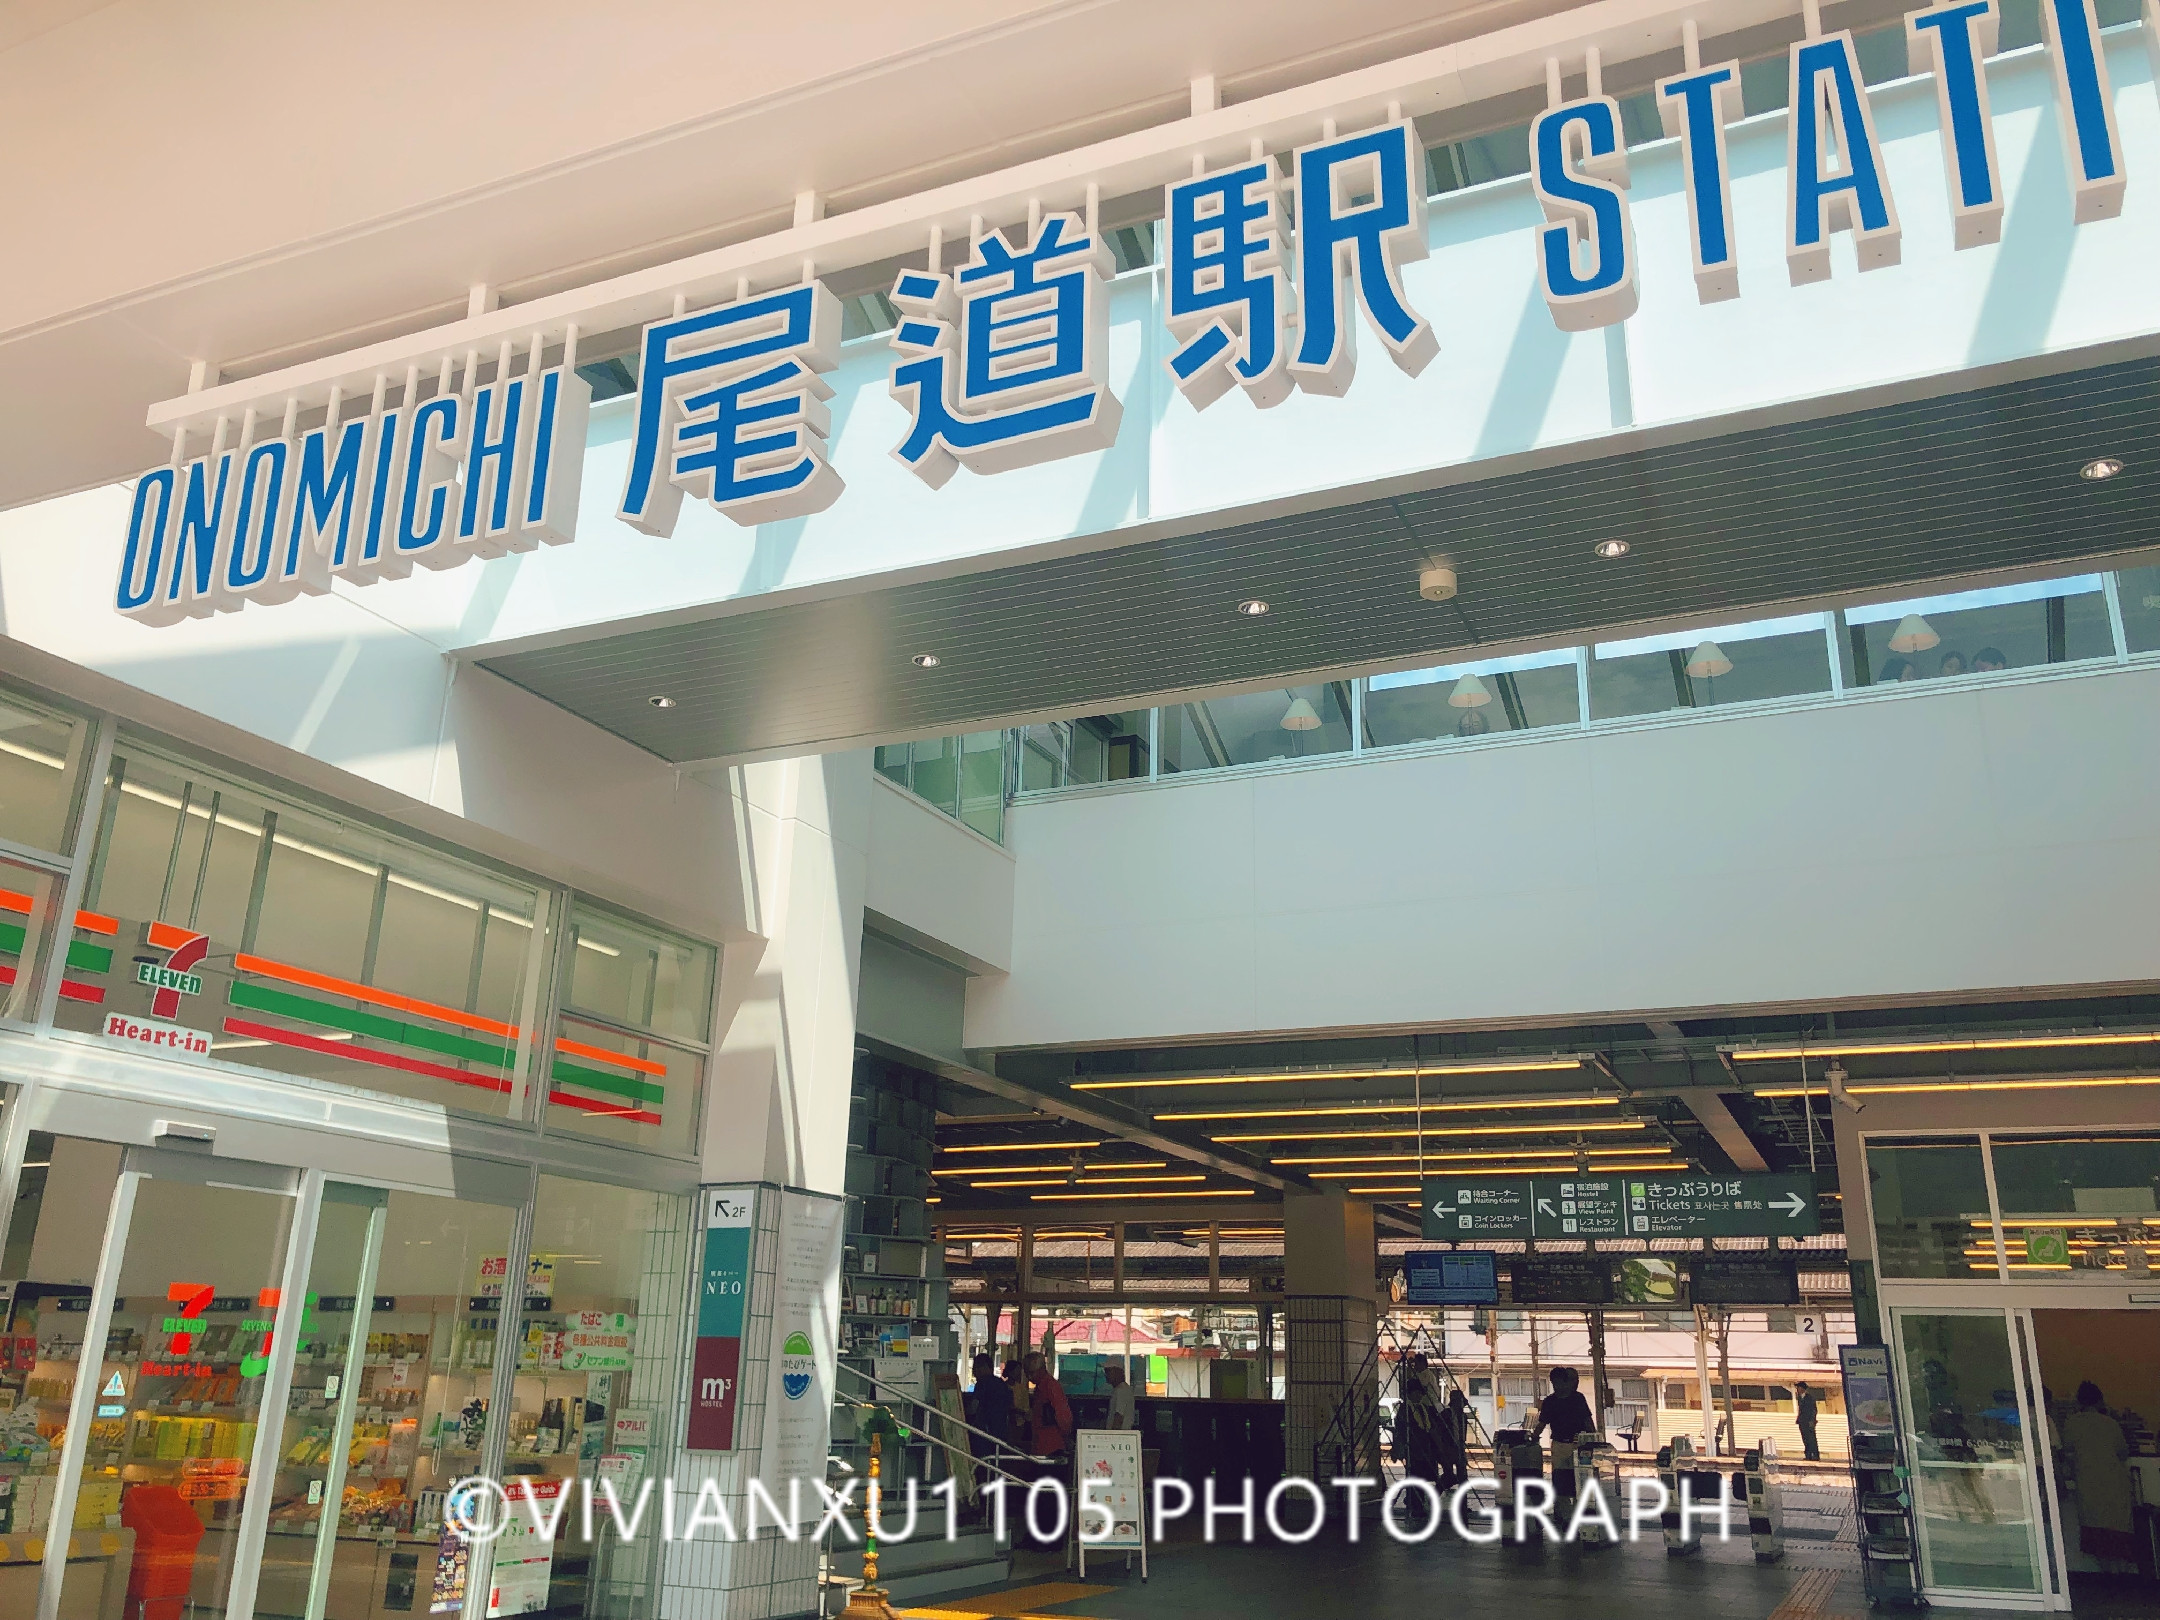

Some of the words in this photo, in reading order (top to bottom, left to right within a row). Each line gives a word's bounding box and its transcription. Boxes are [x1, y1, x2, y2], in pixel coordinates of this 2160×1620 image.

[114, 368, 563, 612] ONOMICHI
[622, 125, 1420, 518] 尾道駅
[107, 1016, 208, 1054] Heart-in
[1648, 1180, 1742, 1197] きっぷうりば
[1473, 1197, 1499, 1205] Waiting
[1649, 1199, 1691, 1210] Tickets
[731, 1206, 747, 1218] 2F
[1474, 1214, 1528, 1223] コインロッカー
[1579, 1218, 1619, 1226] レストラン
[1651, 1215, 1706, 1224] エレベーター
[1651, 1223, 1683, 1231] Elevator
[706, 1280, 742, 1295] NEO
[1803, 1317, 1815, 1333] 2
[1858, 1357, 1883, 1365] Navi
[700, 1400, 723, 1408] HOSTEL
